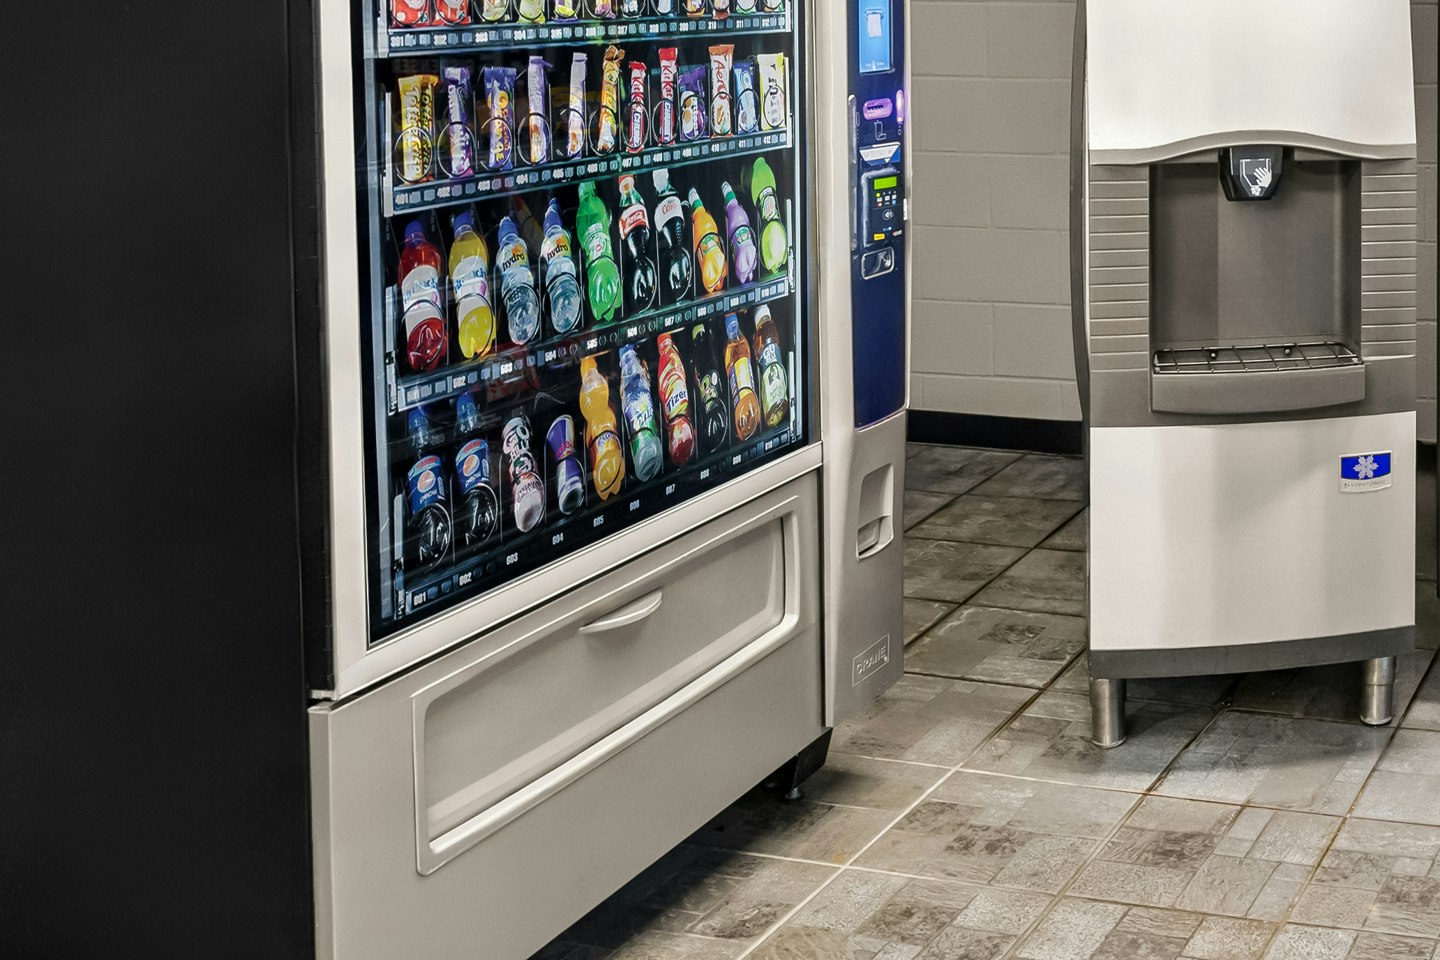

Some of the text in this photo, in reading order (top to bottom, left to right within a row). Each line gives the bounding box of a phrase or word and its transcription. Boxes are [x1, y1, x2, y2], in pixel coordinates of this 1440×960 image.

[661, 65, 674, 98] KitKat
[713, 60, 729, 100] Aero
[502, 252, 524, 273] hydro
[547, 243, 569, 262] hydro
[667, 390, 687, 413] Tizer
